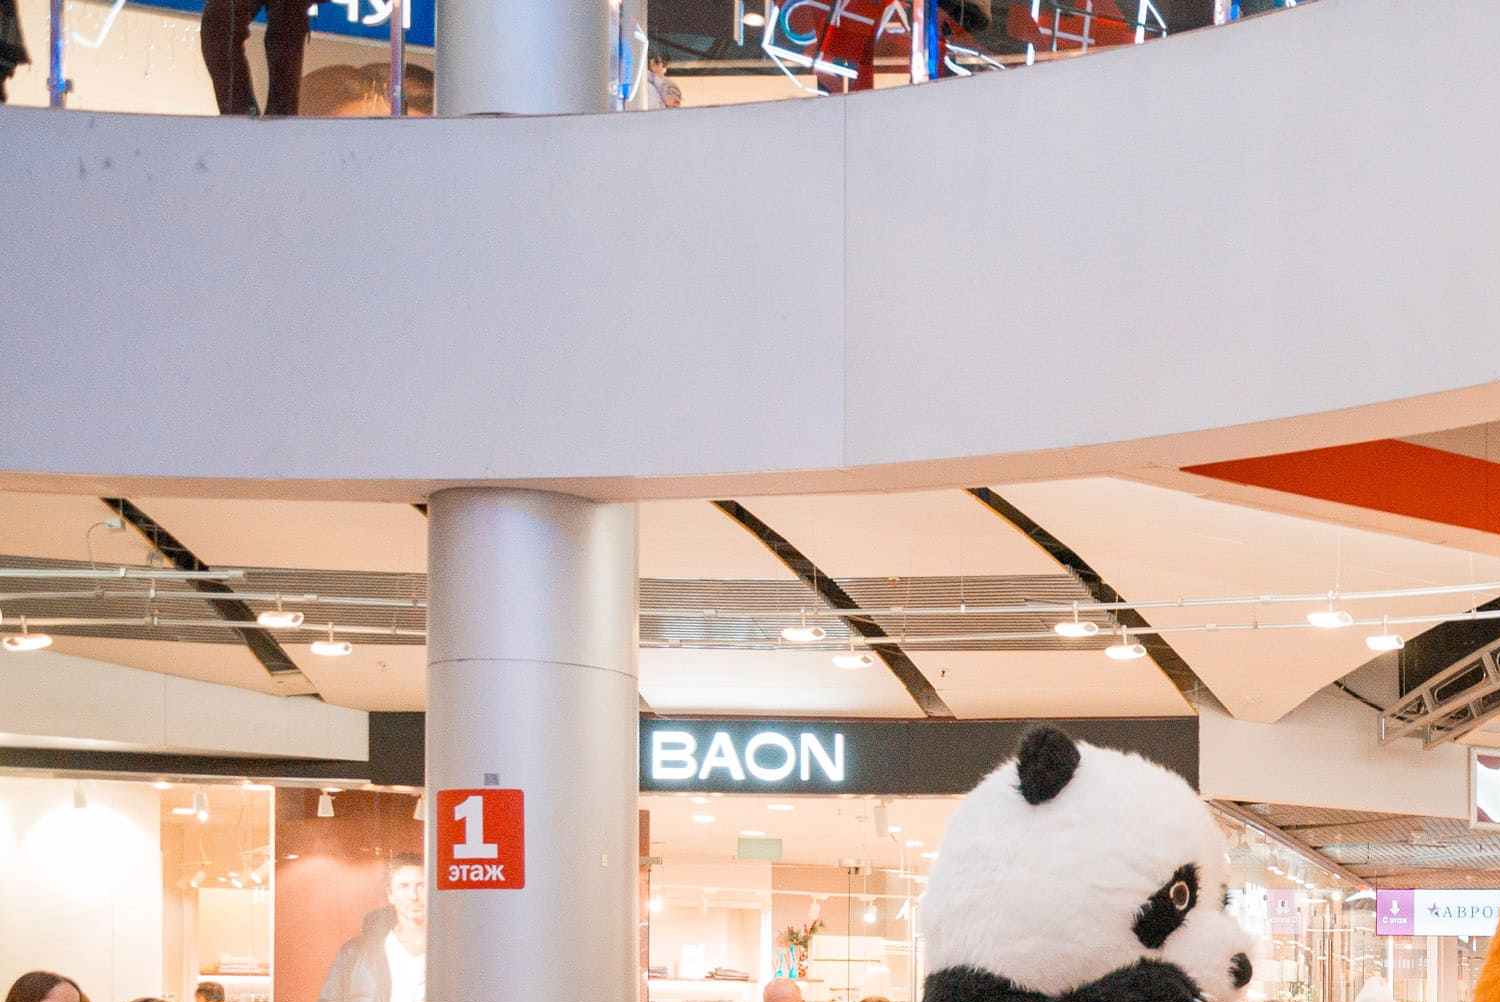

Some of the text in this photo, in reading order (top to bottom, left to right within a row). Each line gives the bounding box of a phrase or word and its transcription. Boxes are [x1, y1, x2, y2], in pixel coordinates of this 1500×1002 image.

[652, 731, 845, 782] BAON
[453, 795, 498, 859] 1
[448, 864, 506, 882] этаж
